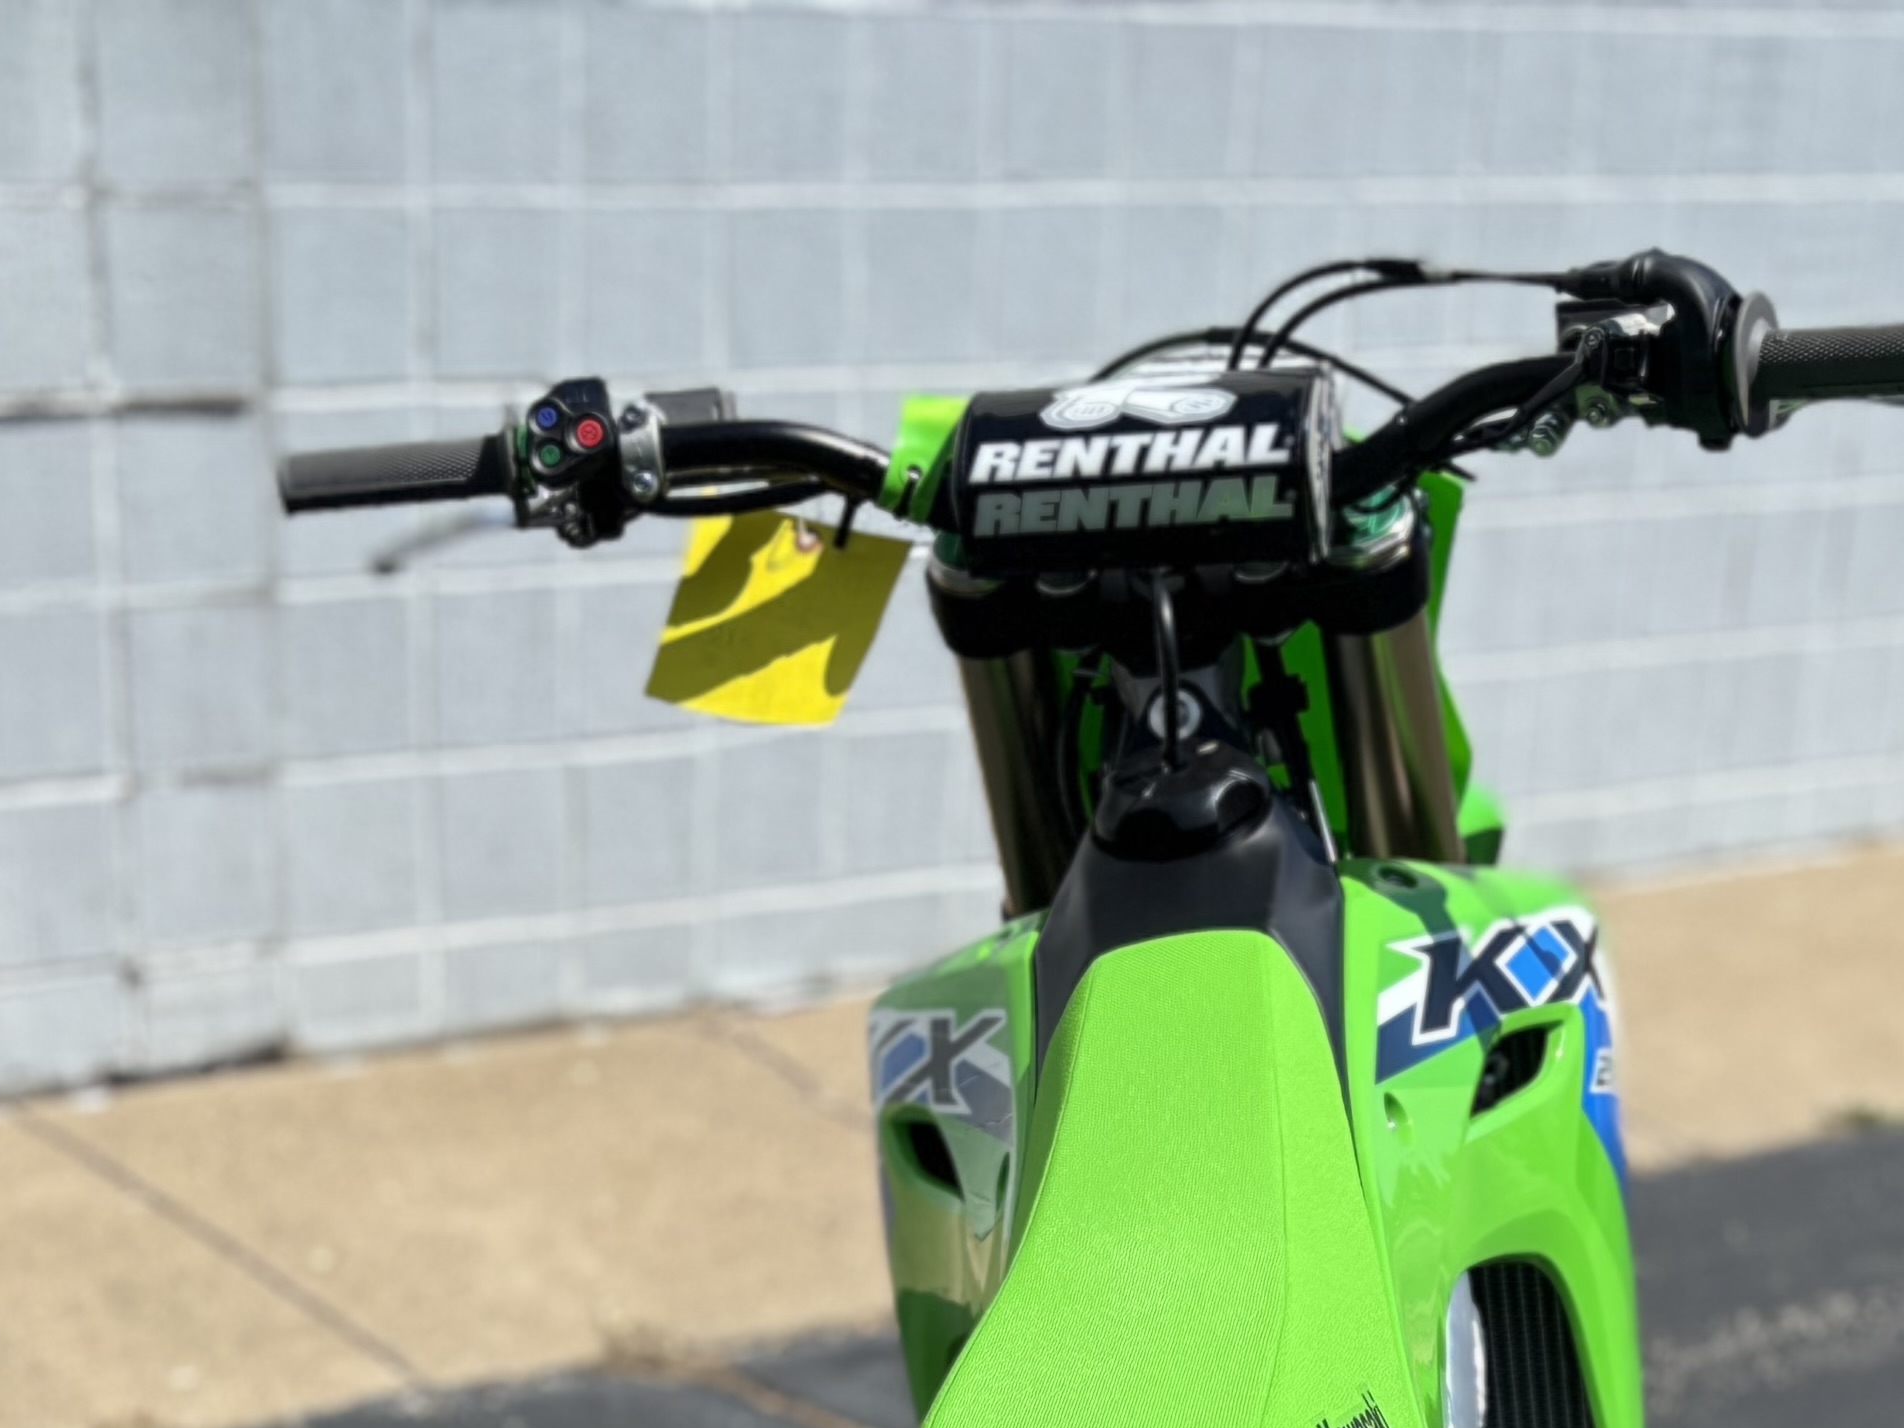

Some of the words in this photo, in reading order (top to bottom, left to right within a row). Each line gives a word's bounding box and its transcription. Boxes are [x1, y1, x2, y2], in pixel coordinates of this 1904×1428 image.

[969, 423, 1291, 484] RENTHAL
[973, 474, 1293, 538] RENTHAL
[1403, 913, 1607, 1039] KX
